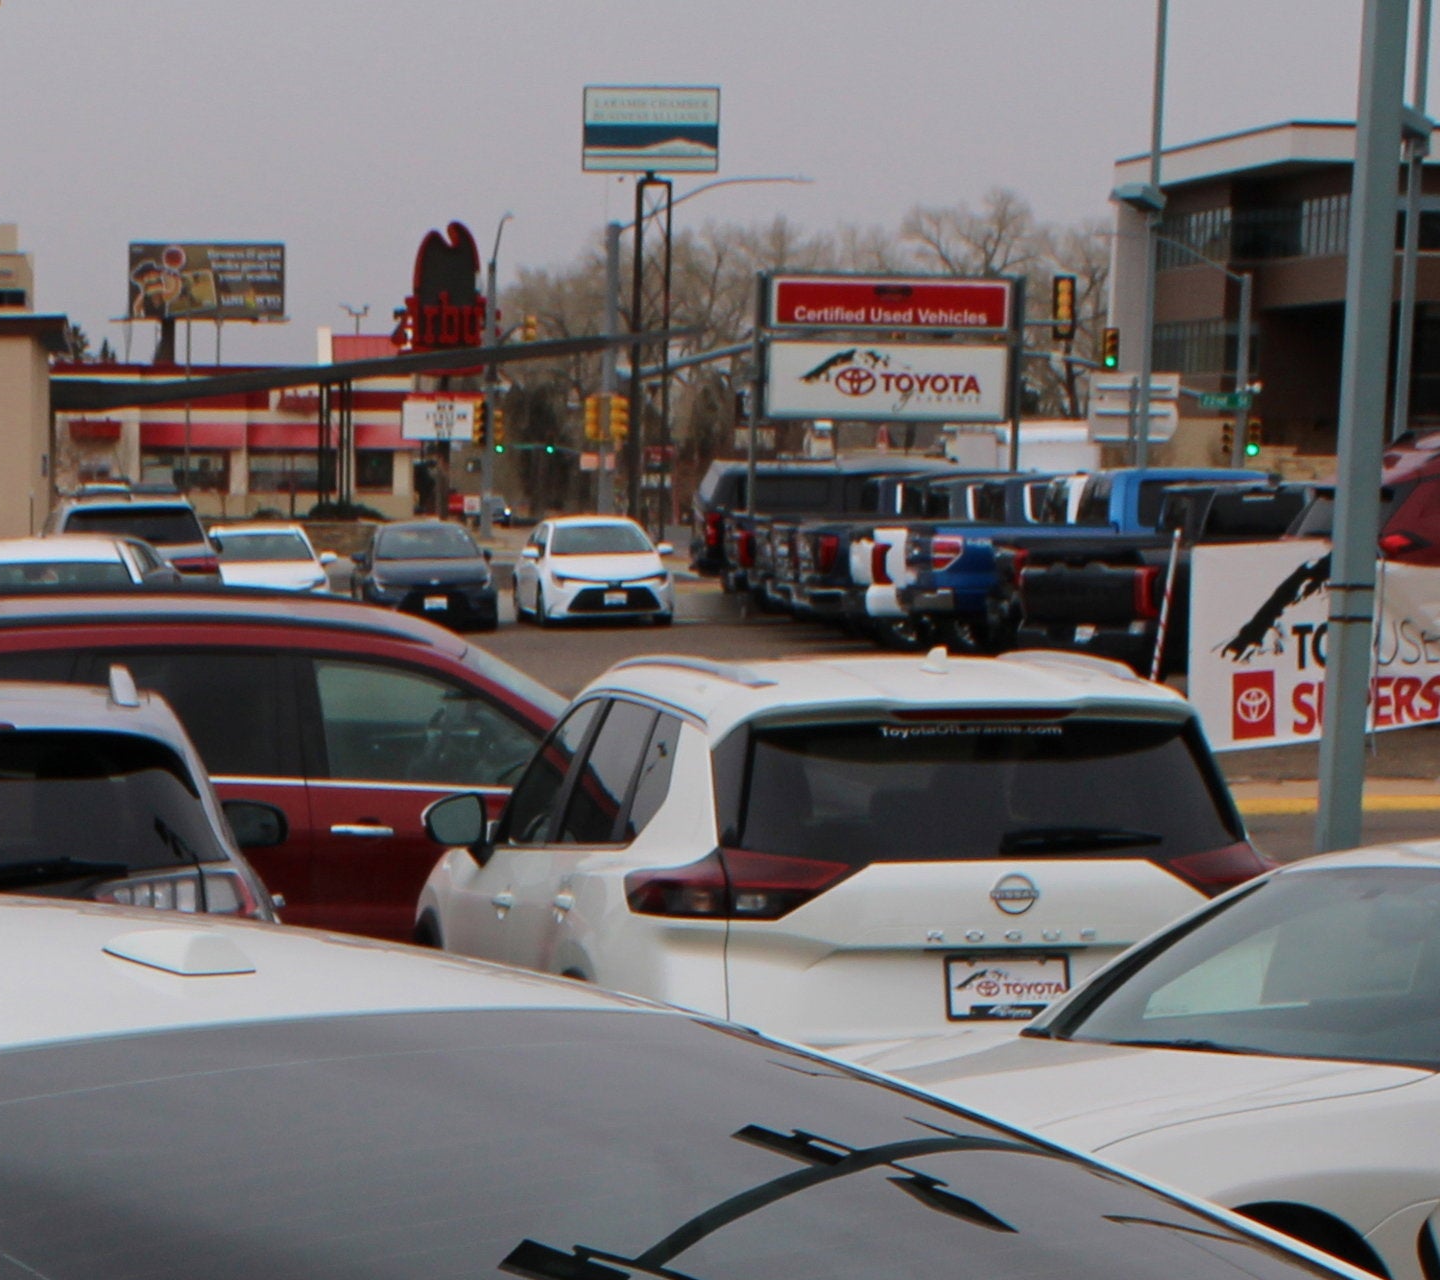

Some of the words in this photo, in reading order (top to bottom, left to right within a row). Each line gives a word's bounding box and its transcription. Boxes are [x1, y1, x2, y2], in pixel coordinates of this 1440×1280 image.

[794, 306, 865, 322] Certified
[870, 307, 913, 323] Used
[917, 308, 988, 325] Vehicles
[880, 373, 981, 394] TOYOTA
[1003, 981, 1068, 995] TOYOTA
